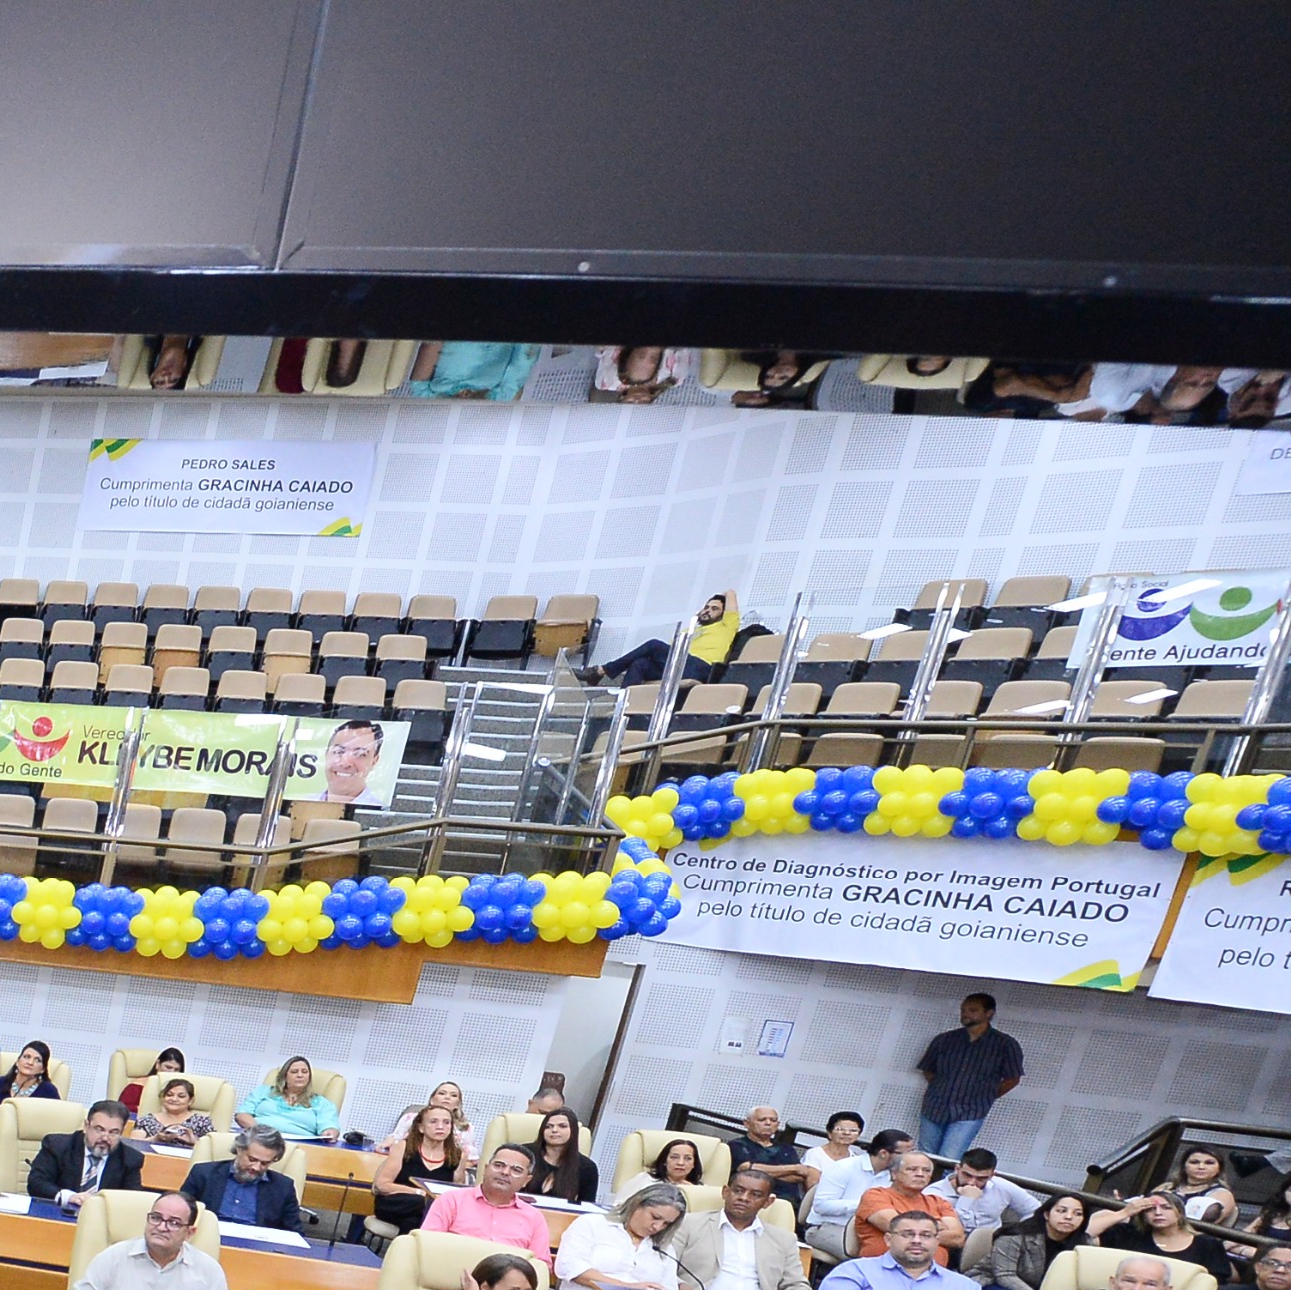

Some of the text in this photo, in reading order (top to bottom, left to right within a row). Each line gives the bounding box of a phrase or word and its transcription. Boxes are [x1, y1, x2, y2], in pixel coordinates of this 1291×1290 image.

[181, 458, 276, 471] PEDRO SALES
[100, 477, 353, 494] Cumprimenta GRACINHA CAIADO
[109, 495, 335, 512] pelo título de cidadã goianiense
[20, 763, 63, 778] Gente
[673, 852, 1161, 900] Centro de Diagnóstico por Imagem Portugal
[683, 873, 1130, 923] Cumprimenta GRACINHA CAIADO
[697, 899, 1089, 948] pelo título de cidadã goianiense
[1217, 947, 1275, 968] pelo
